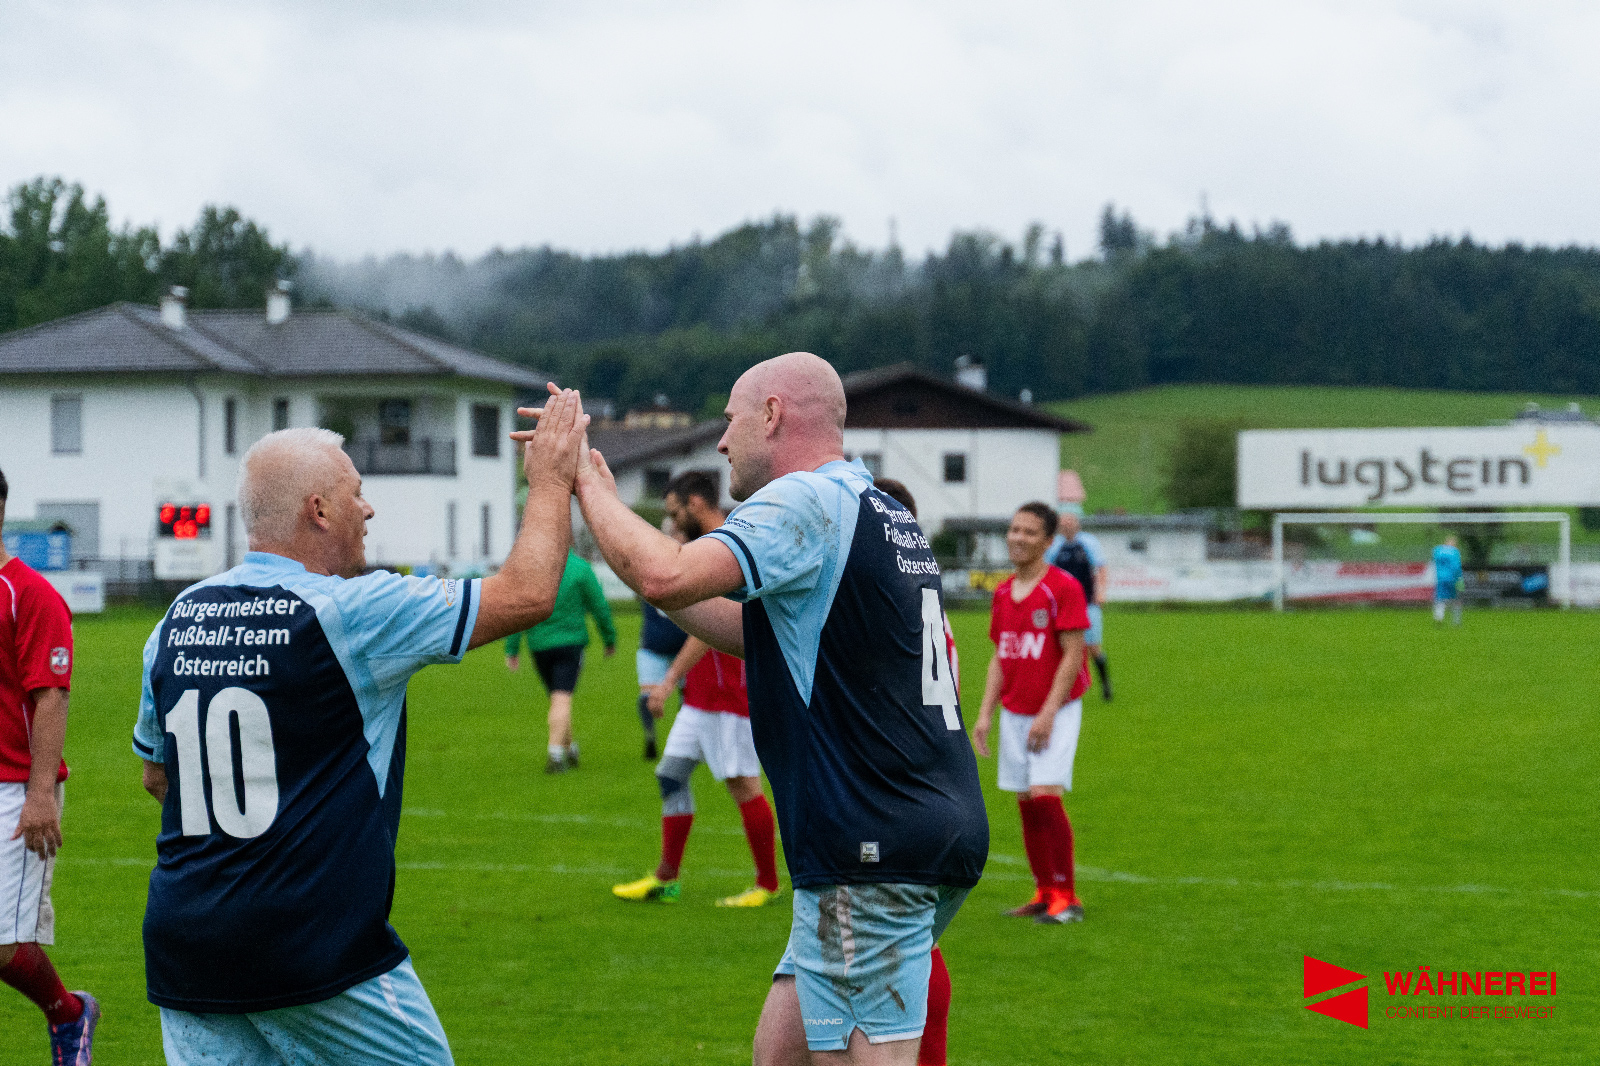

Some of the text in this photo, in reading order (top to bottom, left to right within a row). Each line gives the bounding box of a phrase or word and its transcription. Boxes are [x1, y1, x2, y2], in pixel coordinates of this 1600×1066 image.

[1300, 448, 1530, 503] lugstein
[172, 596, 301, 622] Bürgermeister
[167, 625, 290, 648] Fußball-Team
[173, 651, 270, 676] Österreich
[921, 588, 962, 730] 4
[165, 686, 279, 839] 10
